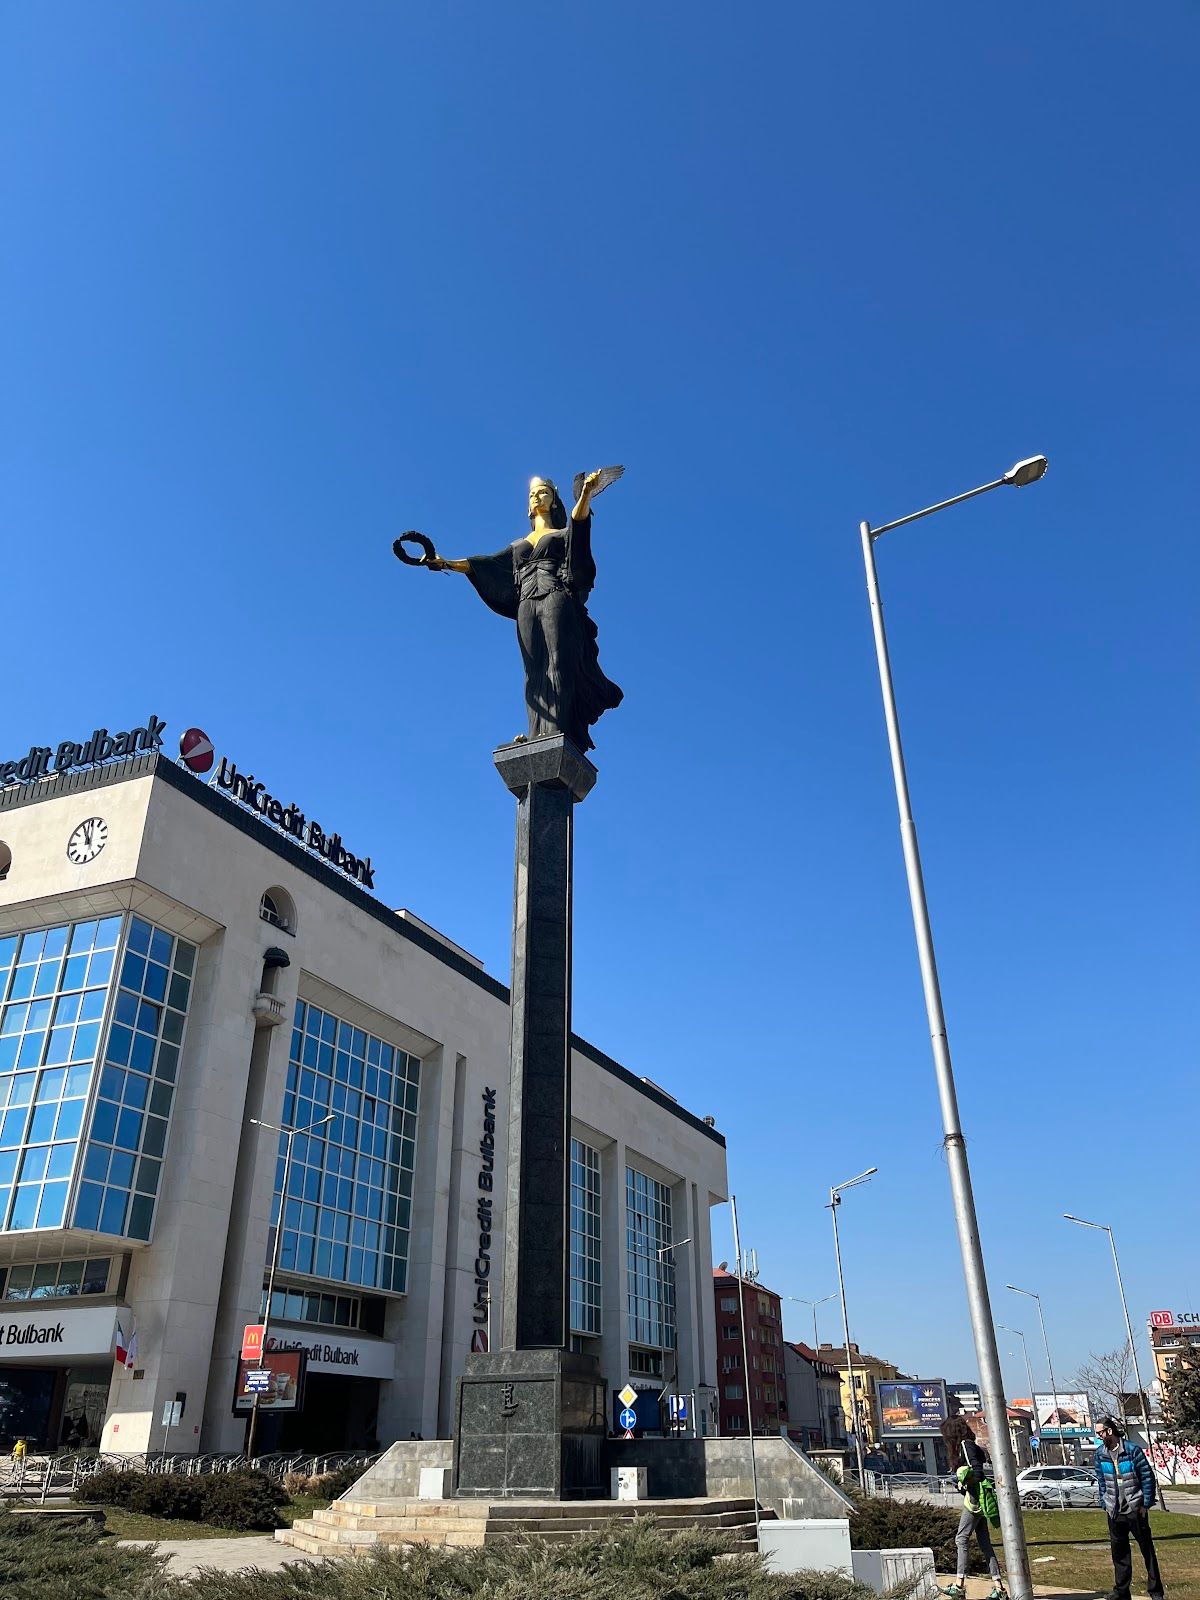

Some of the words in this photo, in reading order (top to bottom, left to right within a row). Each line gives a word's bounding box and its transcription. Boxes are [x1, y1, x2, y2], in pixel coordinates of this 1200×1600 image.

[54, 714, 167, 771] Bulbank
[217, 756, 307, 840] UniCredit
[308, 820, 376, 890] Bulbank
[478, 1086, 497, 1193] Bulbank
[473, 1197, 493, 1324] UniCredit
[6, 1322, 65, 1345] Bulbank
[1153, 1313, 1171, 1325] DB
[1177, 1313, 1200, 1323] SCH
[323, 1345, 359, 1366] Bulbank
